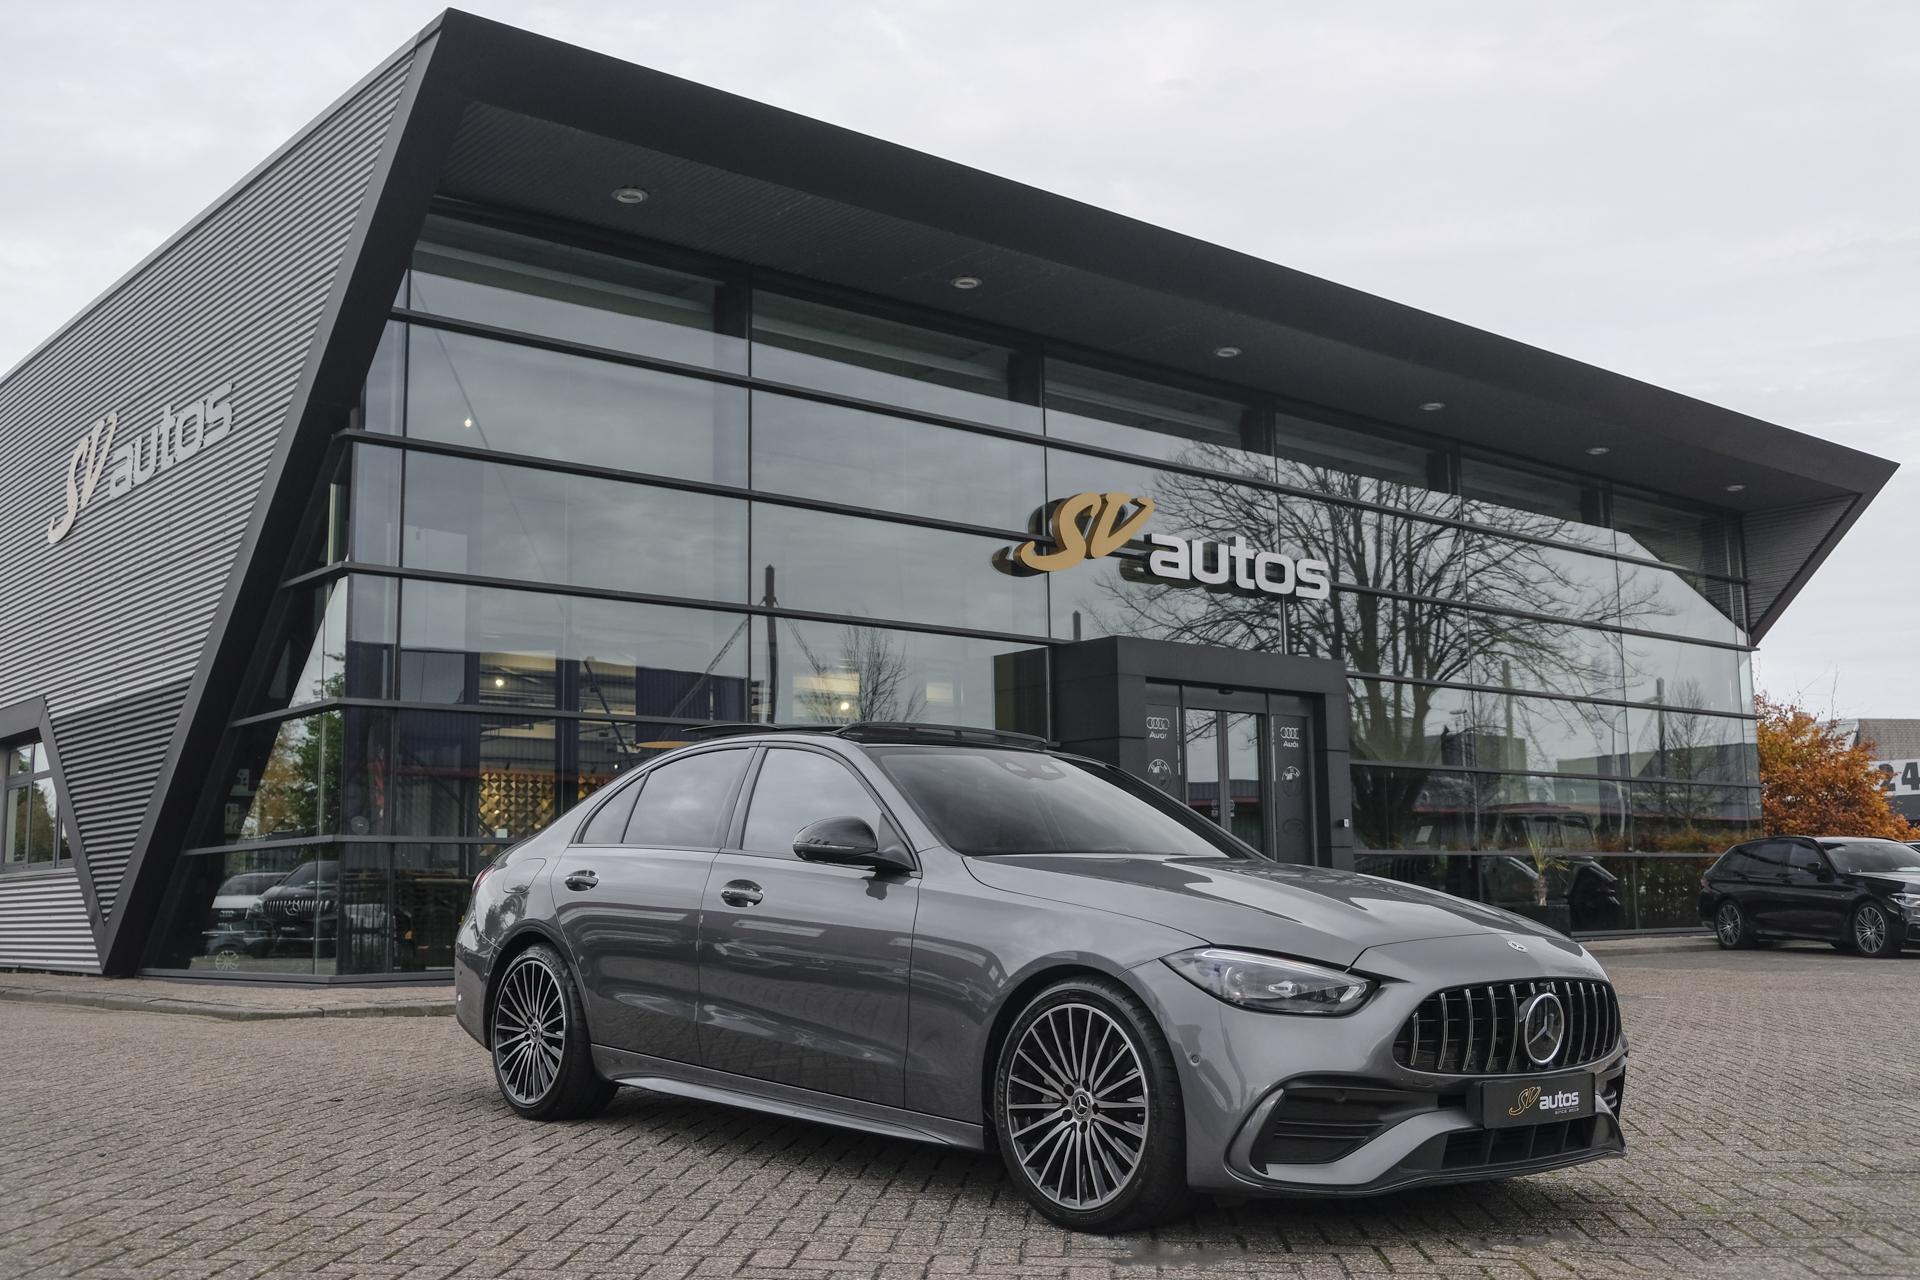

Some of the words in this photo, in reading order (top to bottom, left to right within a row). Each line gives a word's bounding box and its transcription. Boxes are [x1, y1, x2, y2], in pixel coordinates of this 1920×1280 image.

[109, 380, 233, 499] autos
[1019, 492, 1156, 571] SV
[1149, 533, 1330, 600] autos
[1508, 1086, 1542, 1115] SV
[1539, 1091, 1580, 1110] autos
